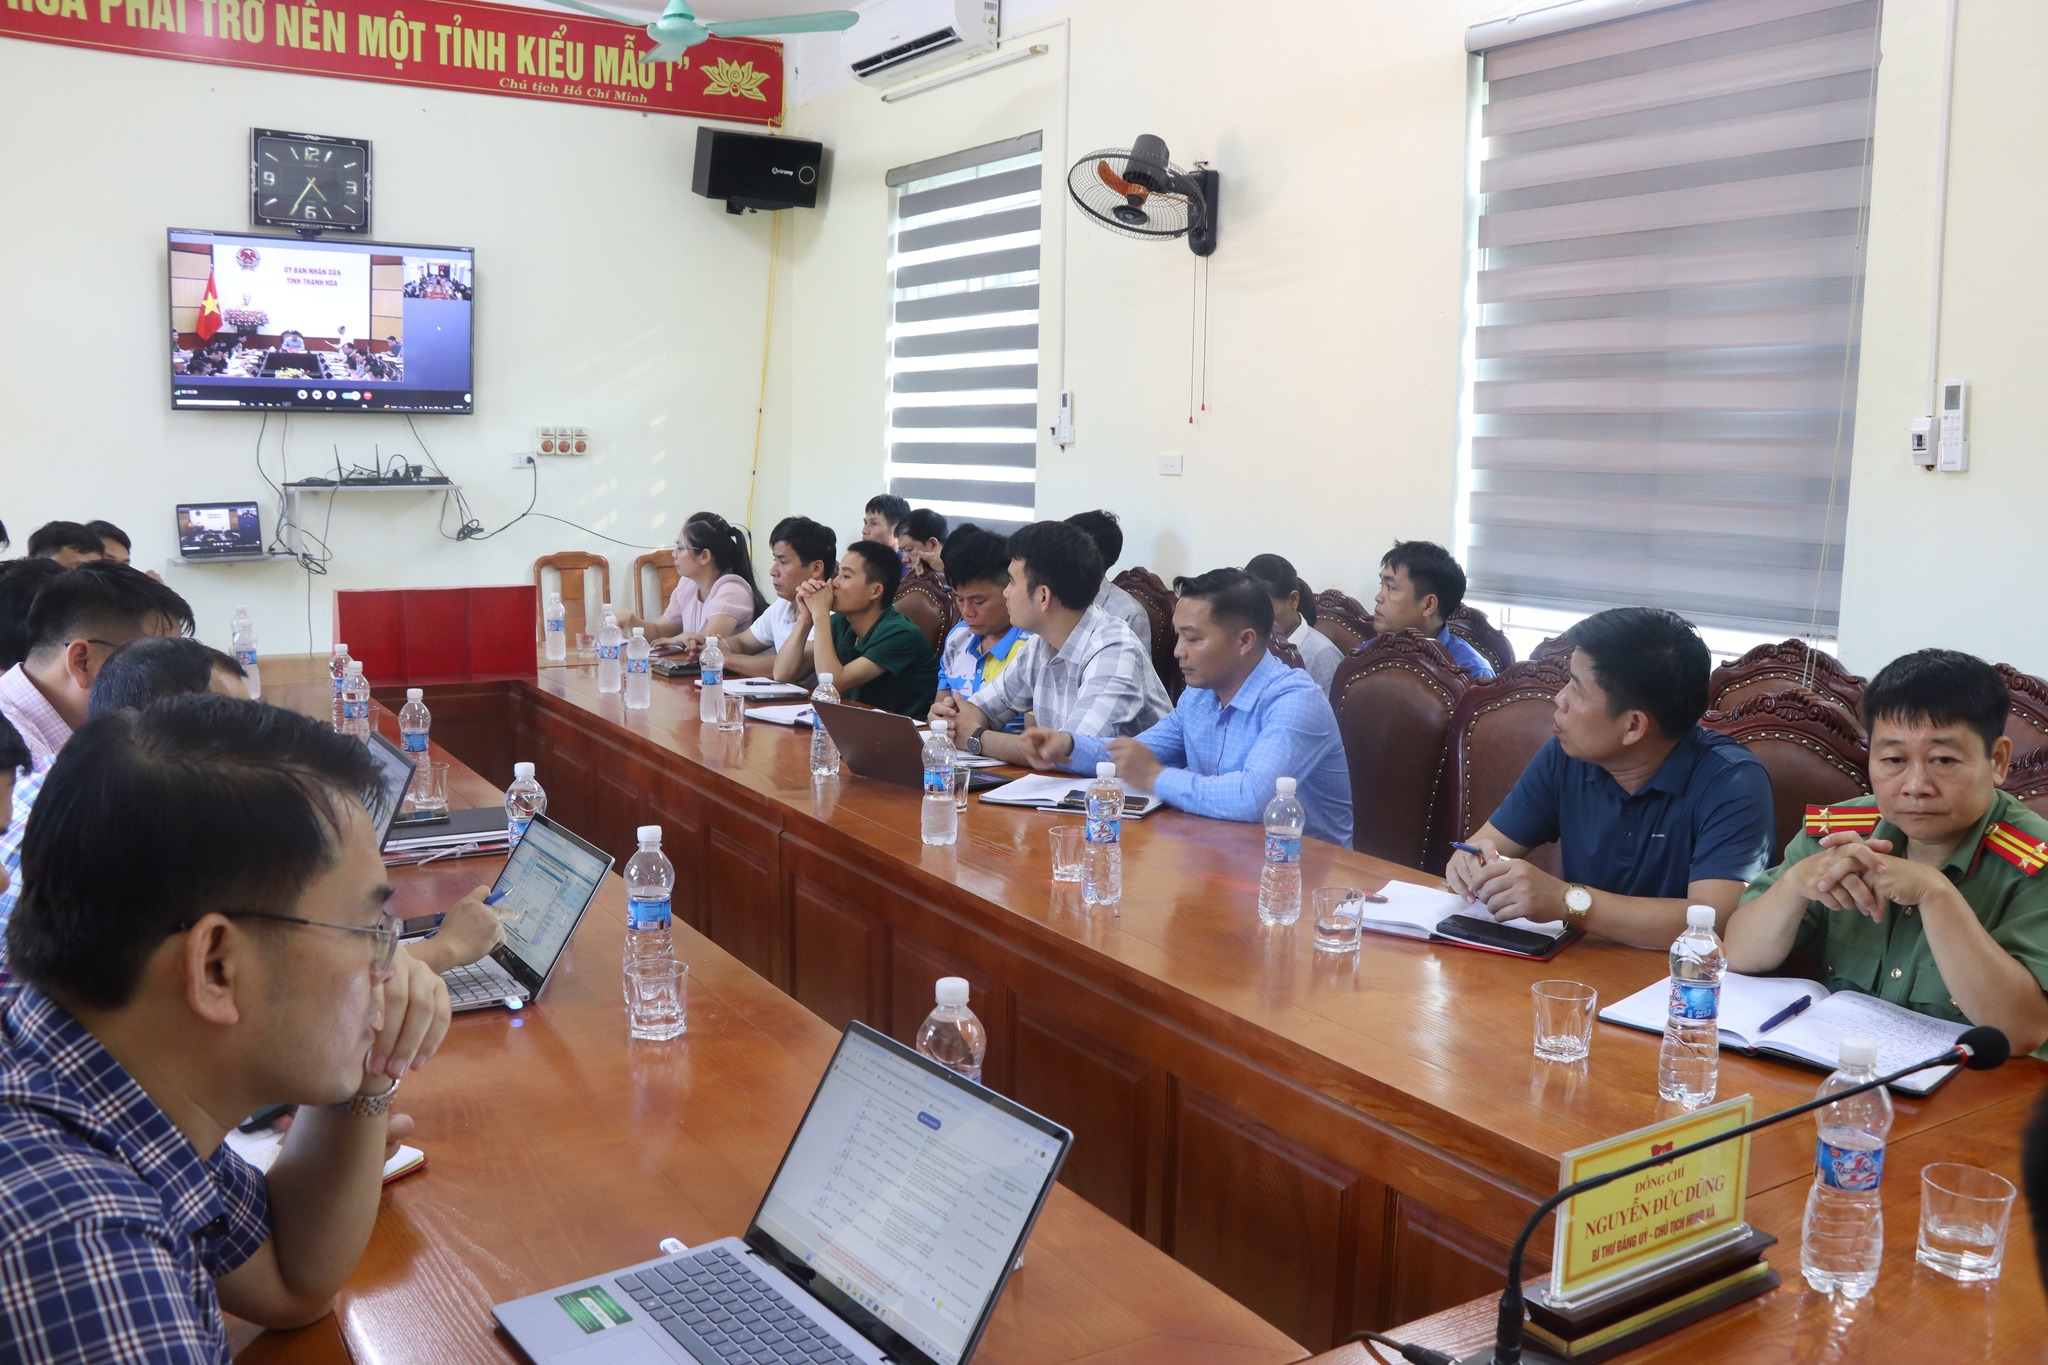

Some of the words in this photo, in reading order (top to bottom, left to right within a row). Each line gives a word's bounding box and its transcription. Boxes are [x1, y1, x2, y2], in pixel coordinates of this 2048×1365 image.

[275, 0, 346, 53] NÊN
[358, 10, 426, 69] MỘT
[434, 14, 507, 73] TỈNH
[516, 23, 584, 81] KIỂU
[594, 34, 656, 90] MẪU
[499, 77, 527, 90] Chủ
[532, 82, 558, 94] tịch
[563, 84, 583, 96] Hồ
[587, 87, 610, 99] Chí
[614, 90, 648, 103] Minh
[304, 146, 319, 162] 12
[263, 171, 275, 186] 9
[346, 180, 358, 195] 3
[304, 205, 317, 219] 6
[1634, 1174, 1665, 1194] ĐỒNG
[1667, 1164, 1685, 1183] CHÍ
[1585, 1197, 1650, 1239] NGUYỄN
[1652, 1188, 1683, 1215] ĐỨC
[1602, 1240, 1616, 1258] THƯ
[1654, 1218, 1669, 1239] CHỦ
[1670, 1216, 1685, 1235] TỊCH
